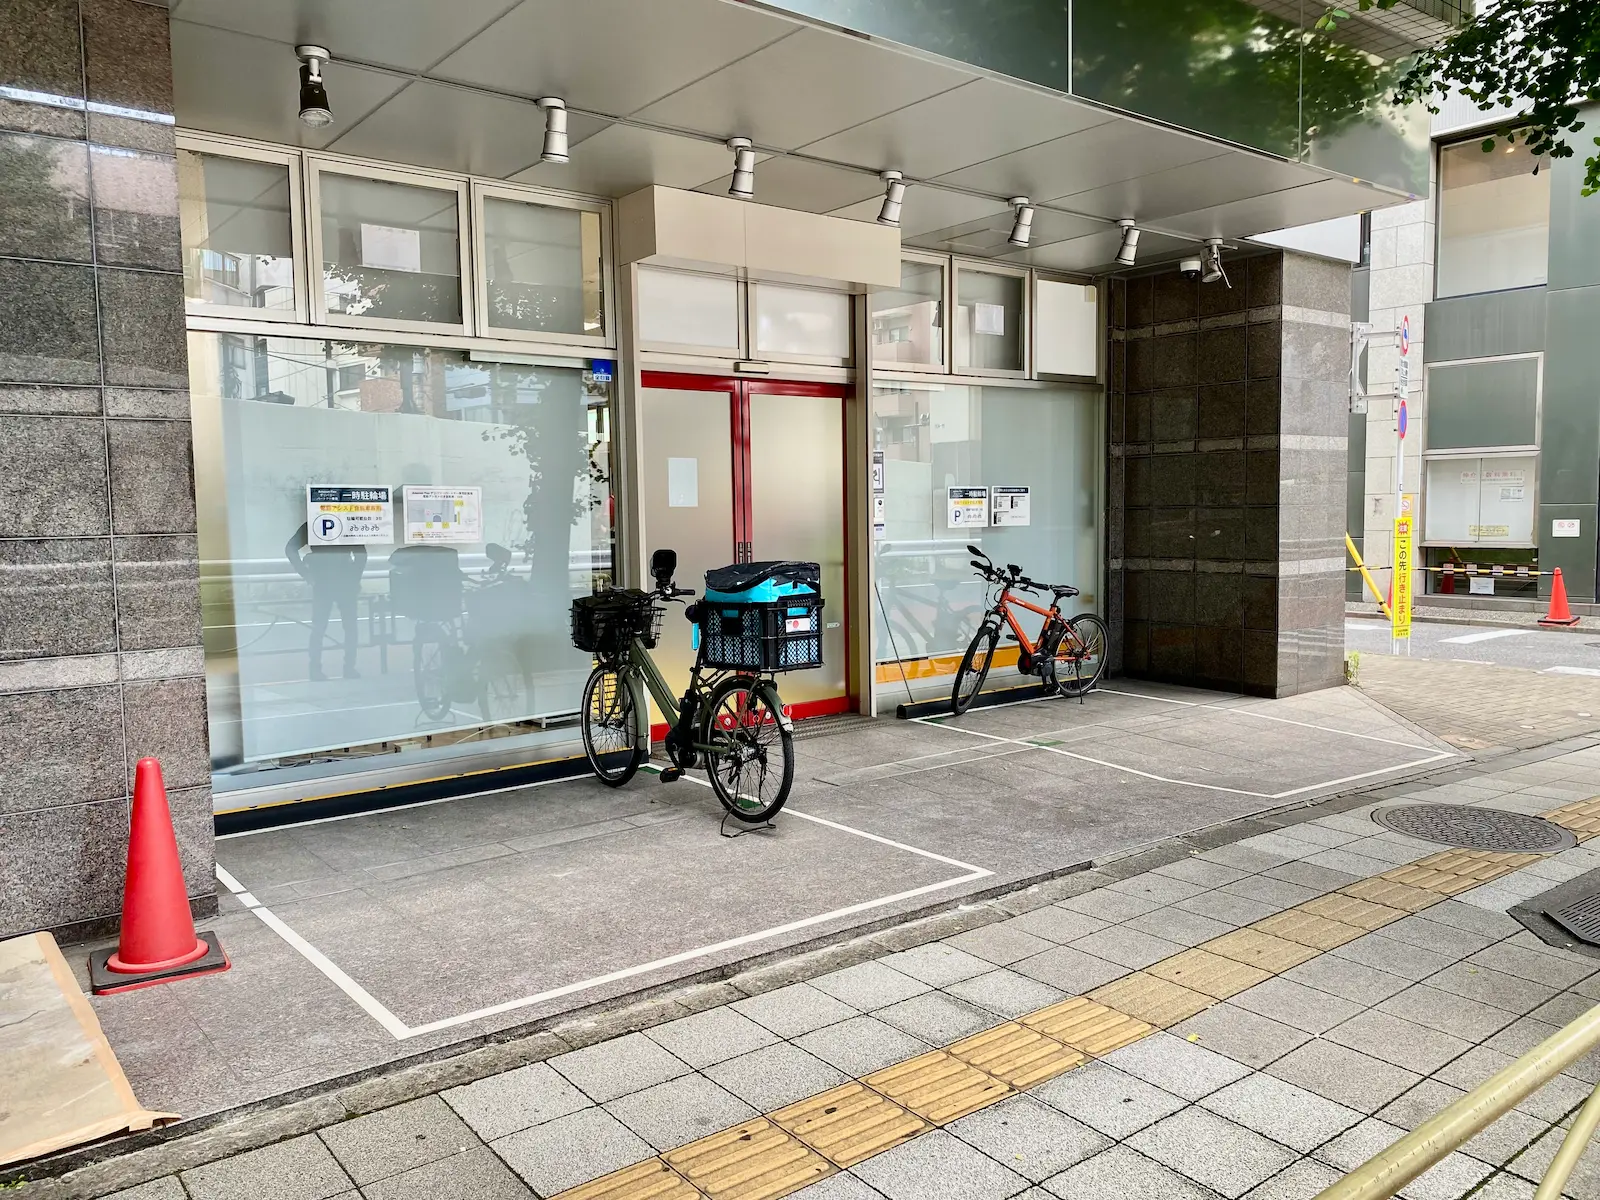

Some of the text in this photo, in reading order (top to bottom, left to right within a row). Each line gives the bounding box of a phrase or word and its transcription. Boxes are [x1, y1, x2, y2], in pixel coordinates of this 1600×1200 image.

[342, 490, 387, 501] 一時駐輪場
[955, 510, 961, 521] P
[322, 519, 334, 536] P
[1398, 539, 1407, 625] この先行き止まり
